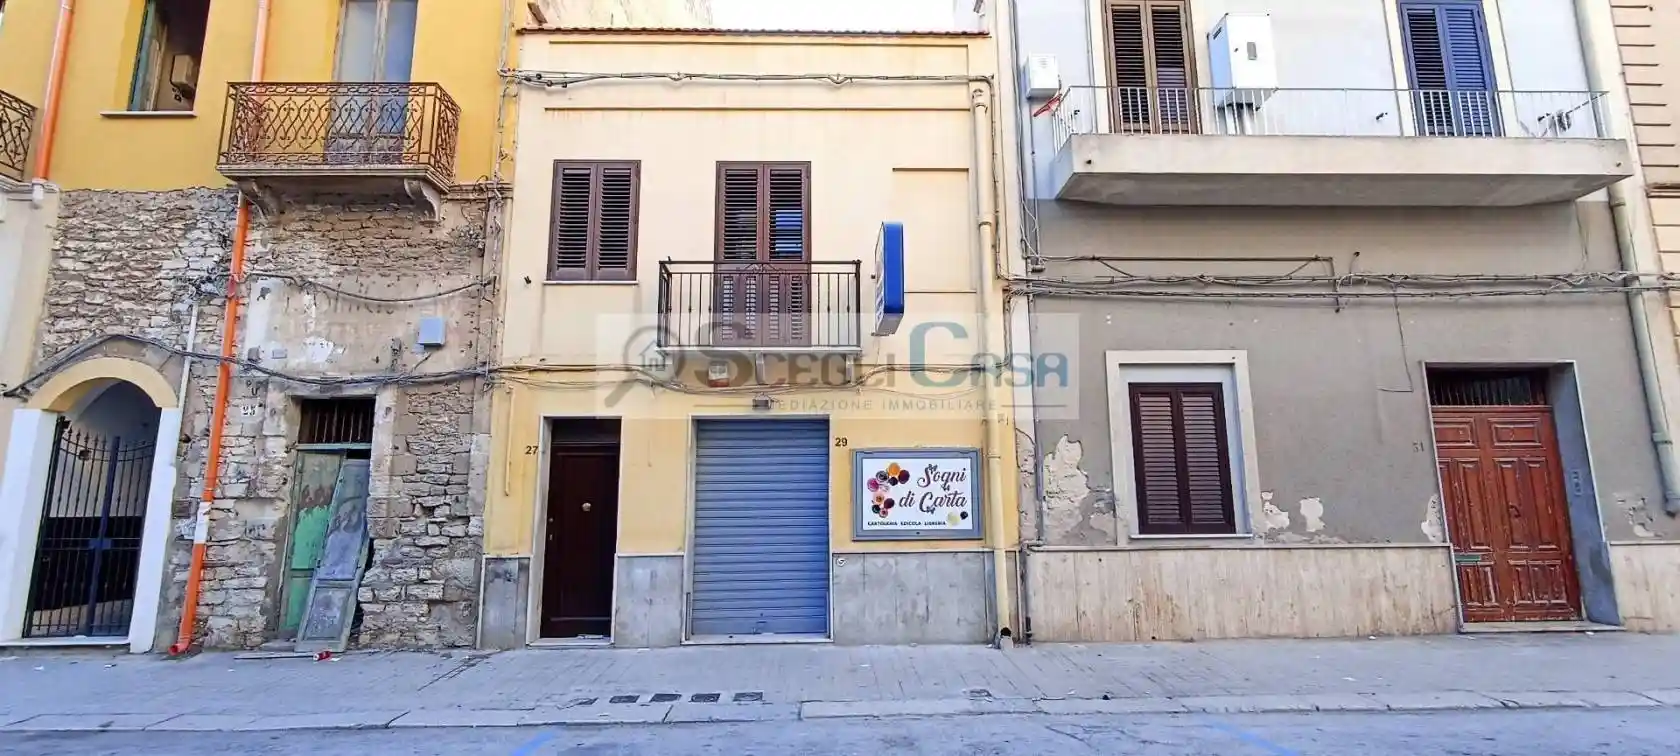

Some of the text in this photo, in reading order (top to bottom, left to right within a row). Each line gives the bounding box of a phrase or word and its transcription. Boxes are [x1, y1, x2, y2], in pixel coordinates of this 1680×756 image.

[525, 445, 539, 455] 27
[835, 437, 848, 447] 29
[917, 464, 967, 488] Sogni
[898, 490, 968, 514] di Carta
